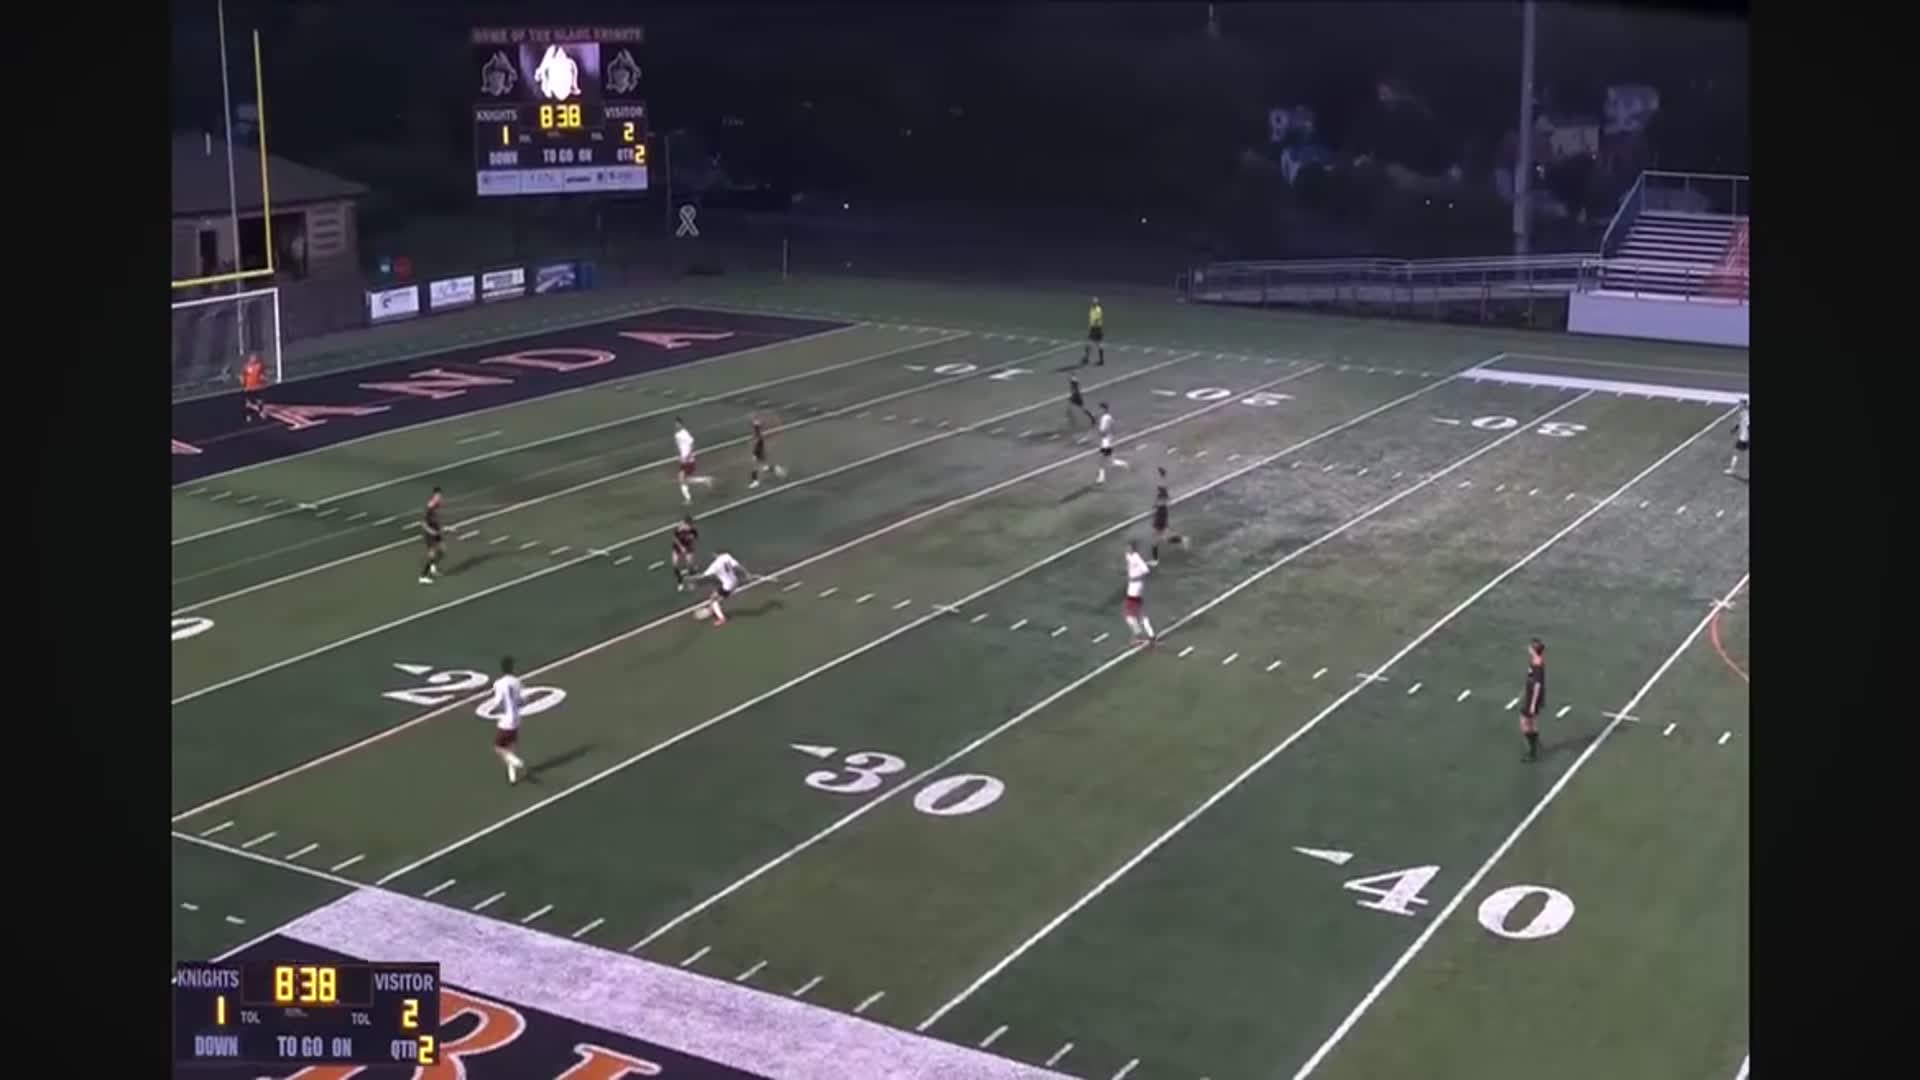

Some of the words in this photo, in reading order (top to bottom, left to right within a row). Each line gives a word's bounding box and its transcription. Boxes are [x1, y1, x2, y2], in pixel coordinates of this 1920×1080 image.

[476, 109, 518, 121] KNIGHTS
[604, 106, 644, 119] VISITOR
[503, 125, 509, 145] 1
[623, 122, 635, 142] 2
[543, 148, 557, 163] TO
[558, 148, 574, 163] GO
[578, 148, 592, 163] ON
[634, 144, 646, 164] 2
[805, 752, 1005, 815] 30
[1343, 864, 1575, 939] 40
